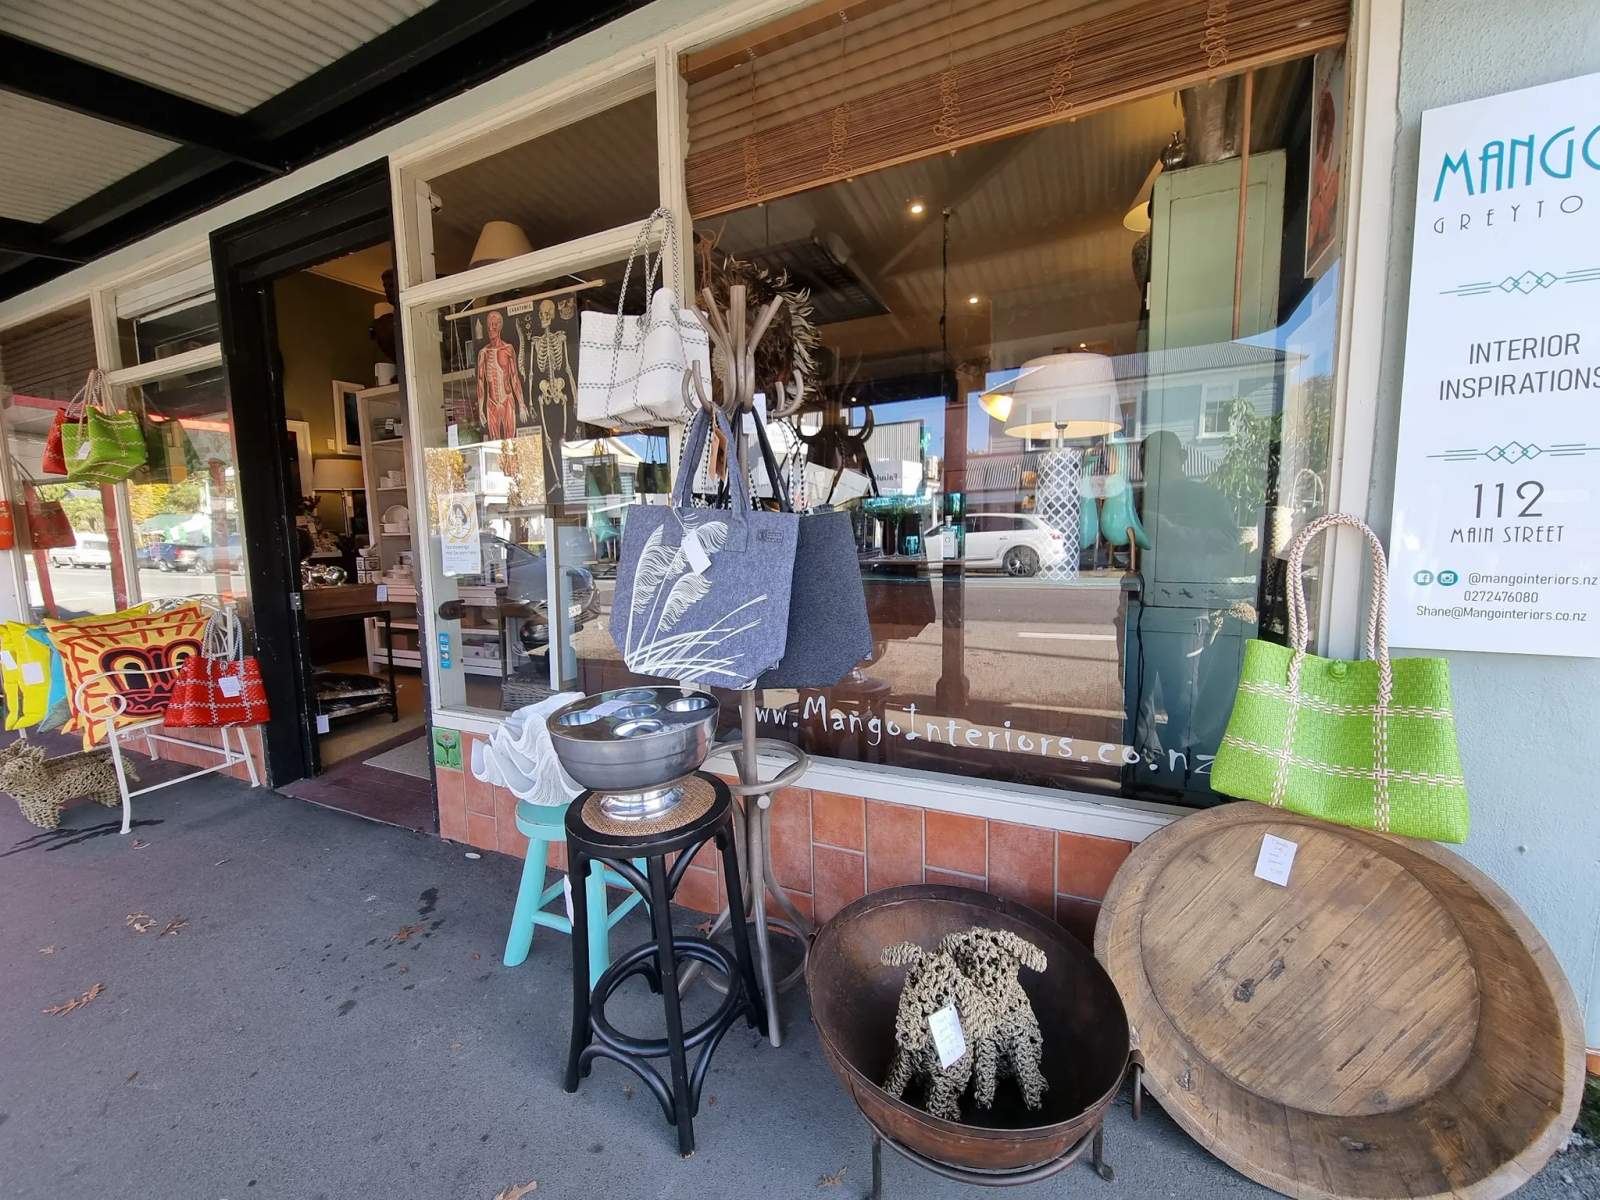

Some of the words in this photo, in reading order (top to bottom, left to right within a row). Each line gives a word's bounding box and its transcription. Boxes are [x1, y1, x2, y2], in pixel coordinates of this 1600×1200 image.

[1469, 332, 1581, 365] INTERIOR
[1474, 480, 1545, 518] 112
[1450, 526, 1494, 543] MAIN
[1503, 525, 1565, 543] STREET
[1467, 572, 1598, 587] @mangointeriors.nz
[1463, 590, 1539, 603] 0272476080
[1416, 605, 1588, 622] Shane@Mangointeriors.co.nz
